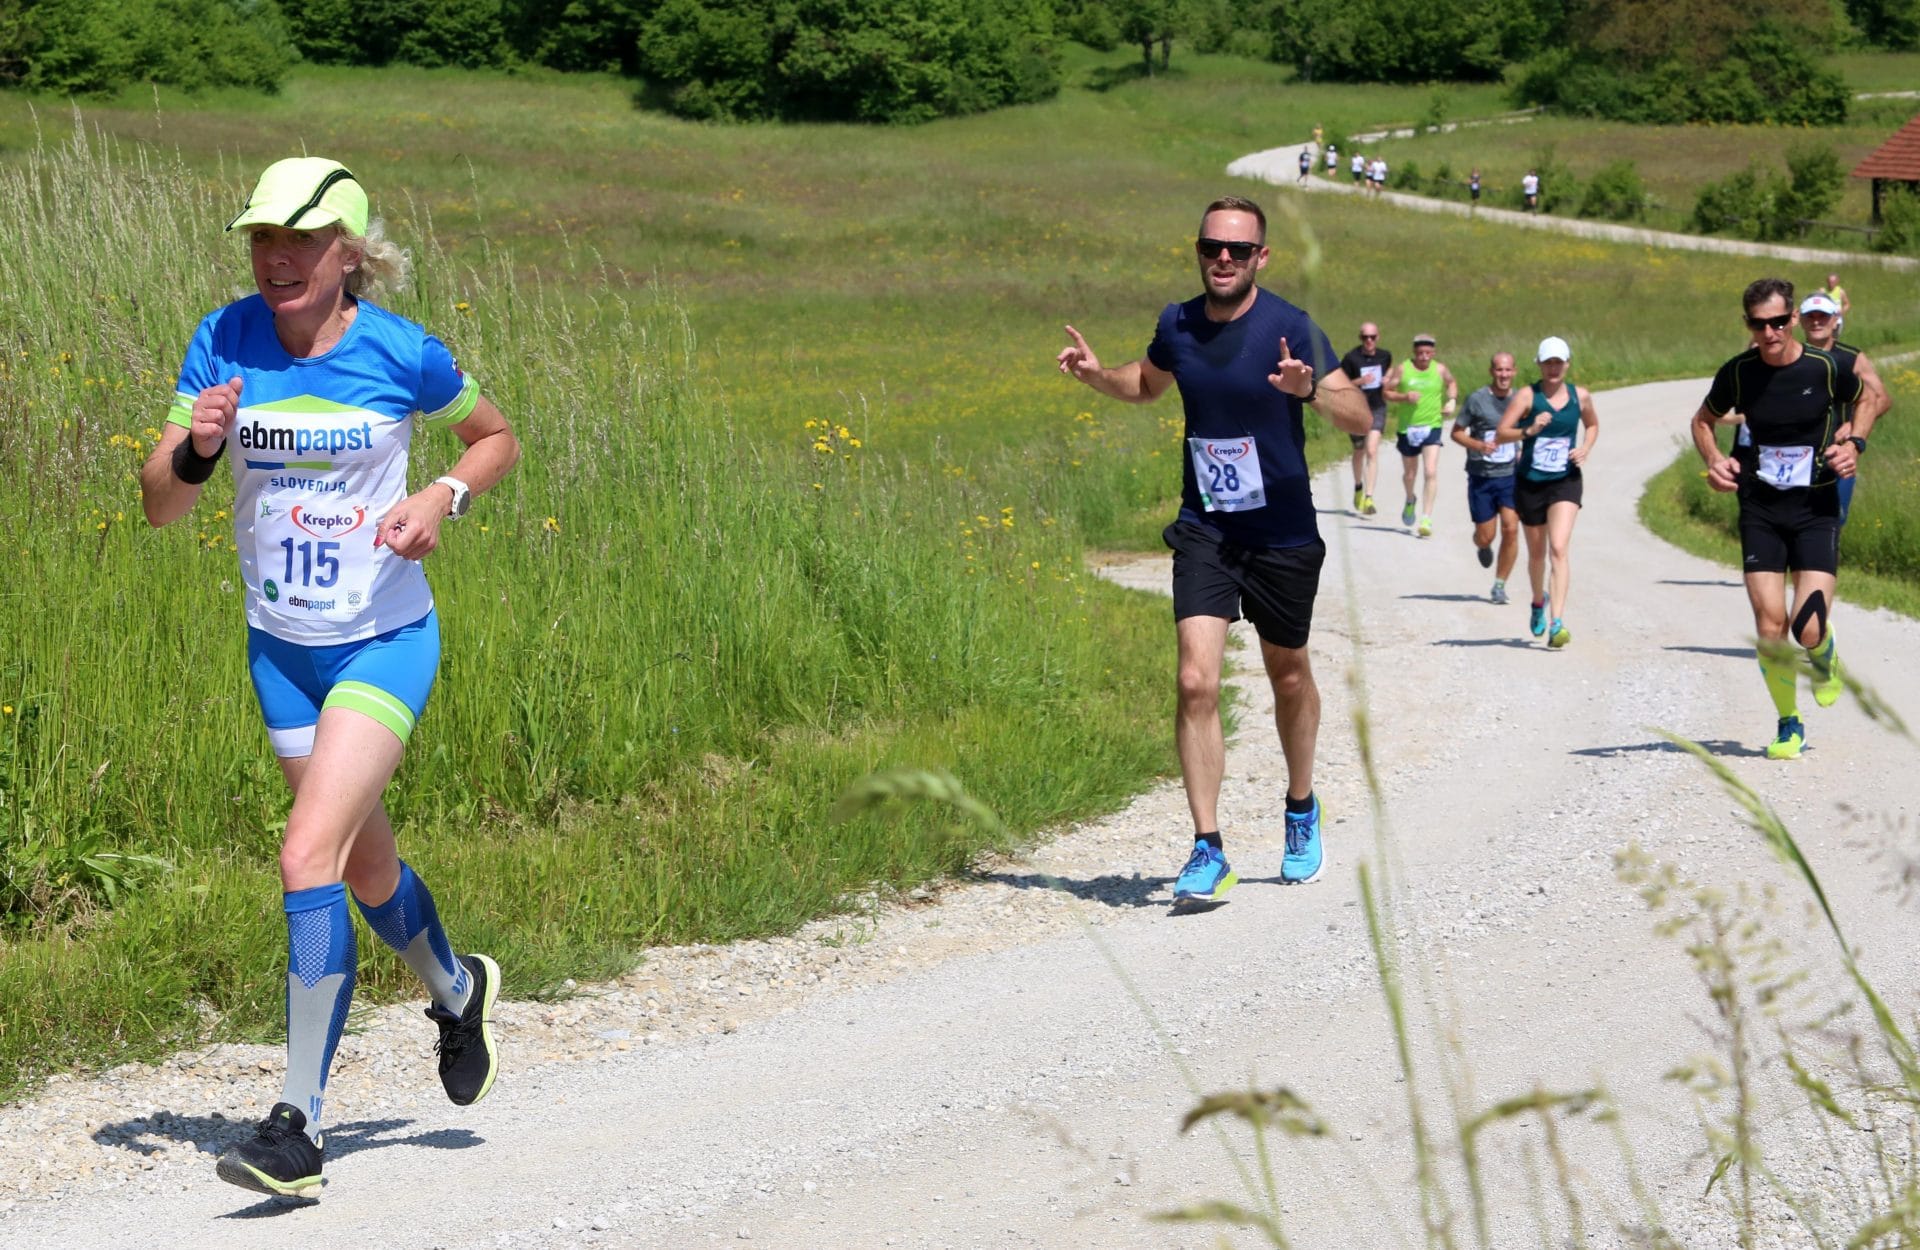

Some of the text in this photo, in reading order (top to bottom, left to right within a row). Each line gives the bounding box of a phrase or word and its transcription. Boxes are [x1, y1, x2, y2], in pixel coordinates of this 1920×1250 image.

[239, 421, 373, 455] ebmpapst
[1214, 447, 1243, 457] Krepko
[271, 477, 347, 493] SLOVENIJA
[1208, 463, 1240, 492] 28
[303, 513, 353, 529] Krepko
[281, 537, 340, 588] 115
[289, 595, 336, 612] ebmpapst
